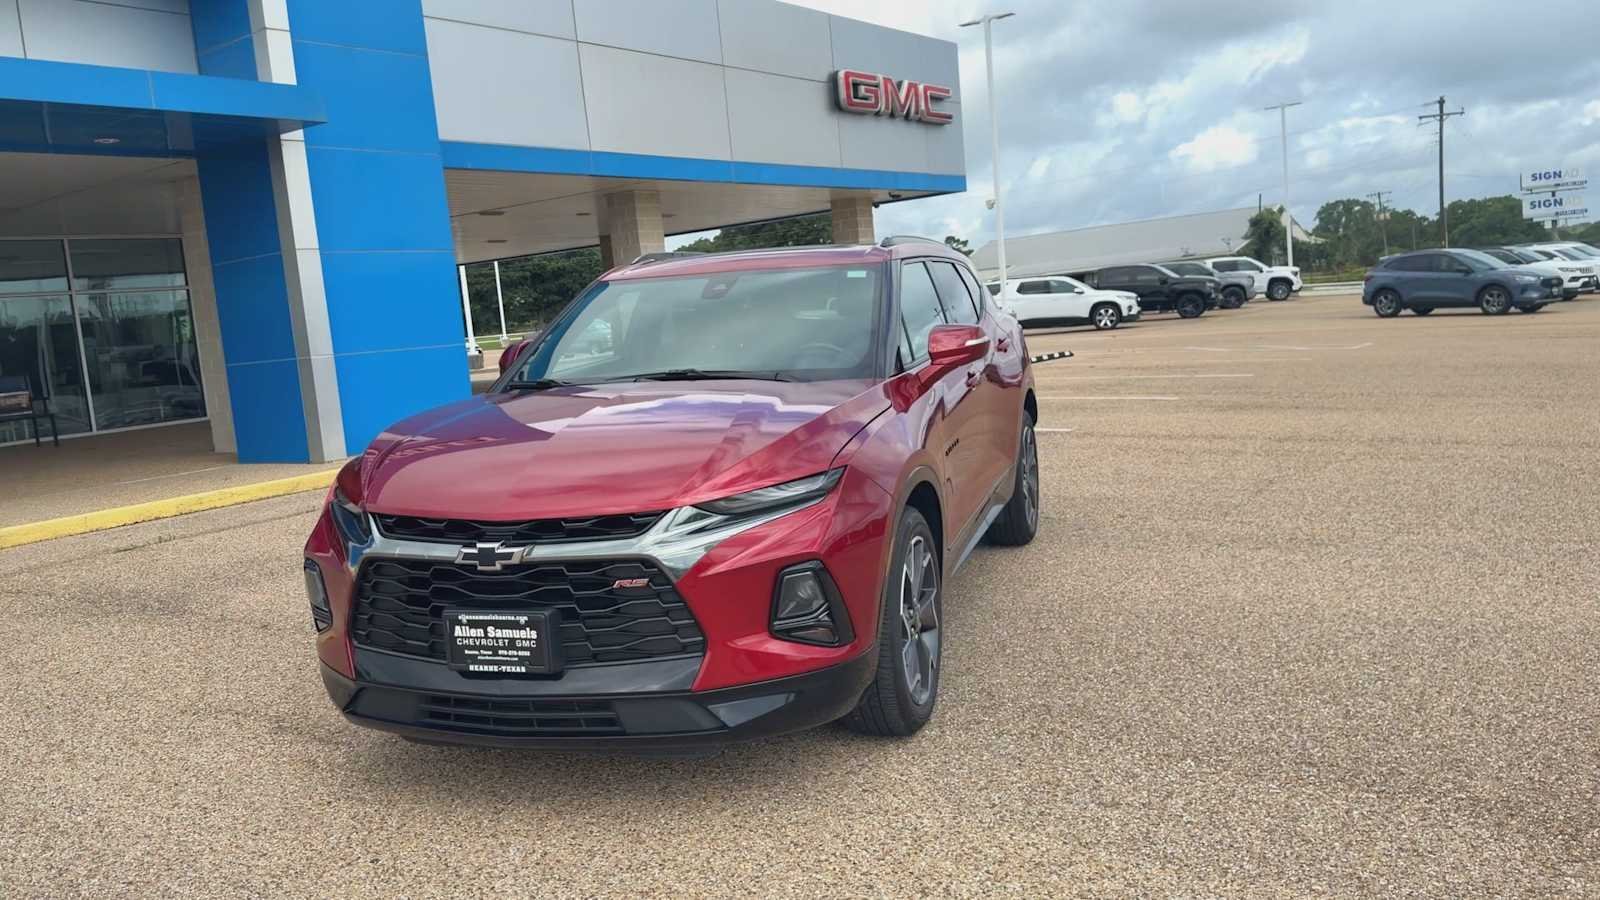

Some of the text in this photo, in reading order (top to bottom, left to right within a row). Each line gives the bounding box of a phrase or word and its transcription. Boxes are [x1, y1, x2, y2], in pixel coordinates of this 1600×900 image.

[836, 69, 954, 125] GMC
[612, 578, 650, 588] RS
[454, 625, 538, 639] Allen Samuels
[456, 638, 537, 647] CHEVROLET GMC
